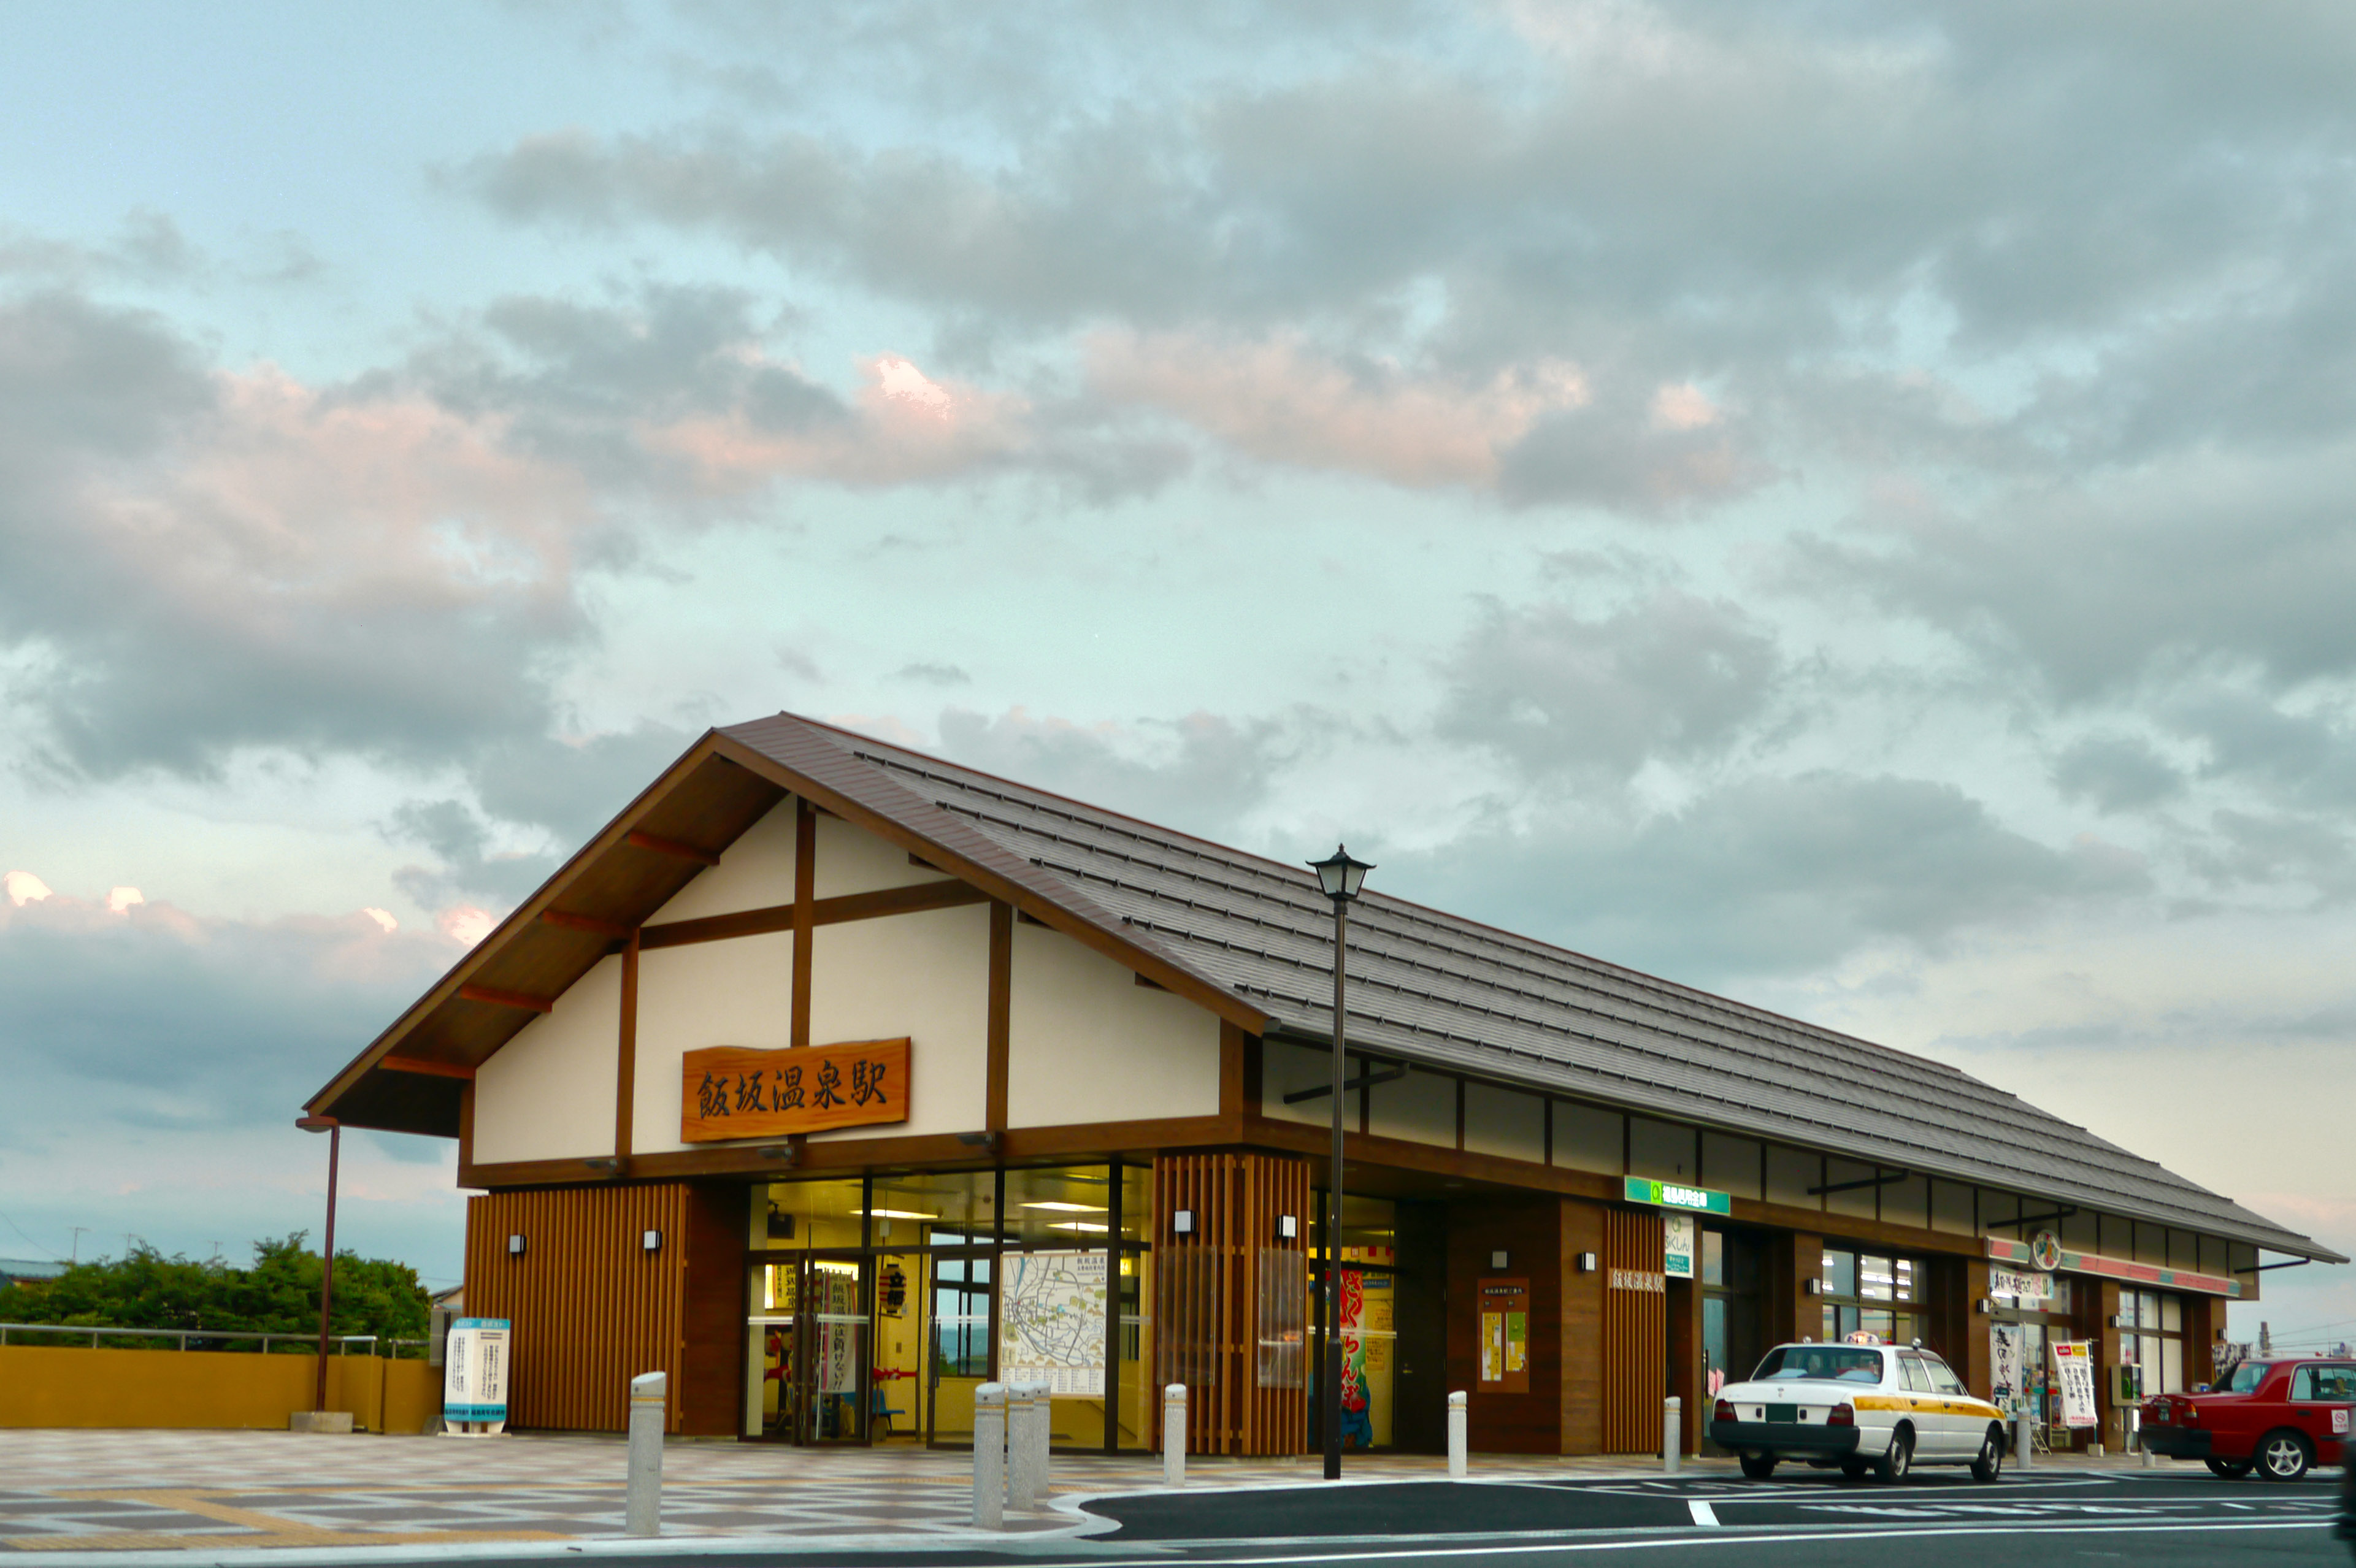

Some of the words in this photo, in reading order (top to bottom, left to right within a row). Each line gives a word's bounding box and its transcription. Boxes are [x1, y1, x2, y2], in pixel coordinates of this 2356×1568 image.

[697, 1060, 886, 1120] 飯坂温泉駅
[1662, 1185, 1708, 1207] 福島信用金庫
[1613, 1269, 1663, 1293] 飯坂温泉駅
